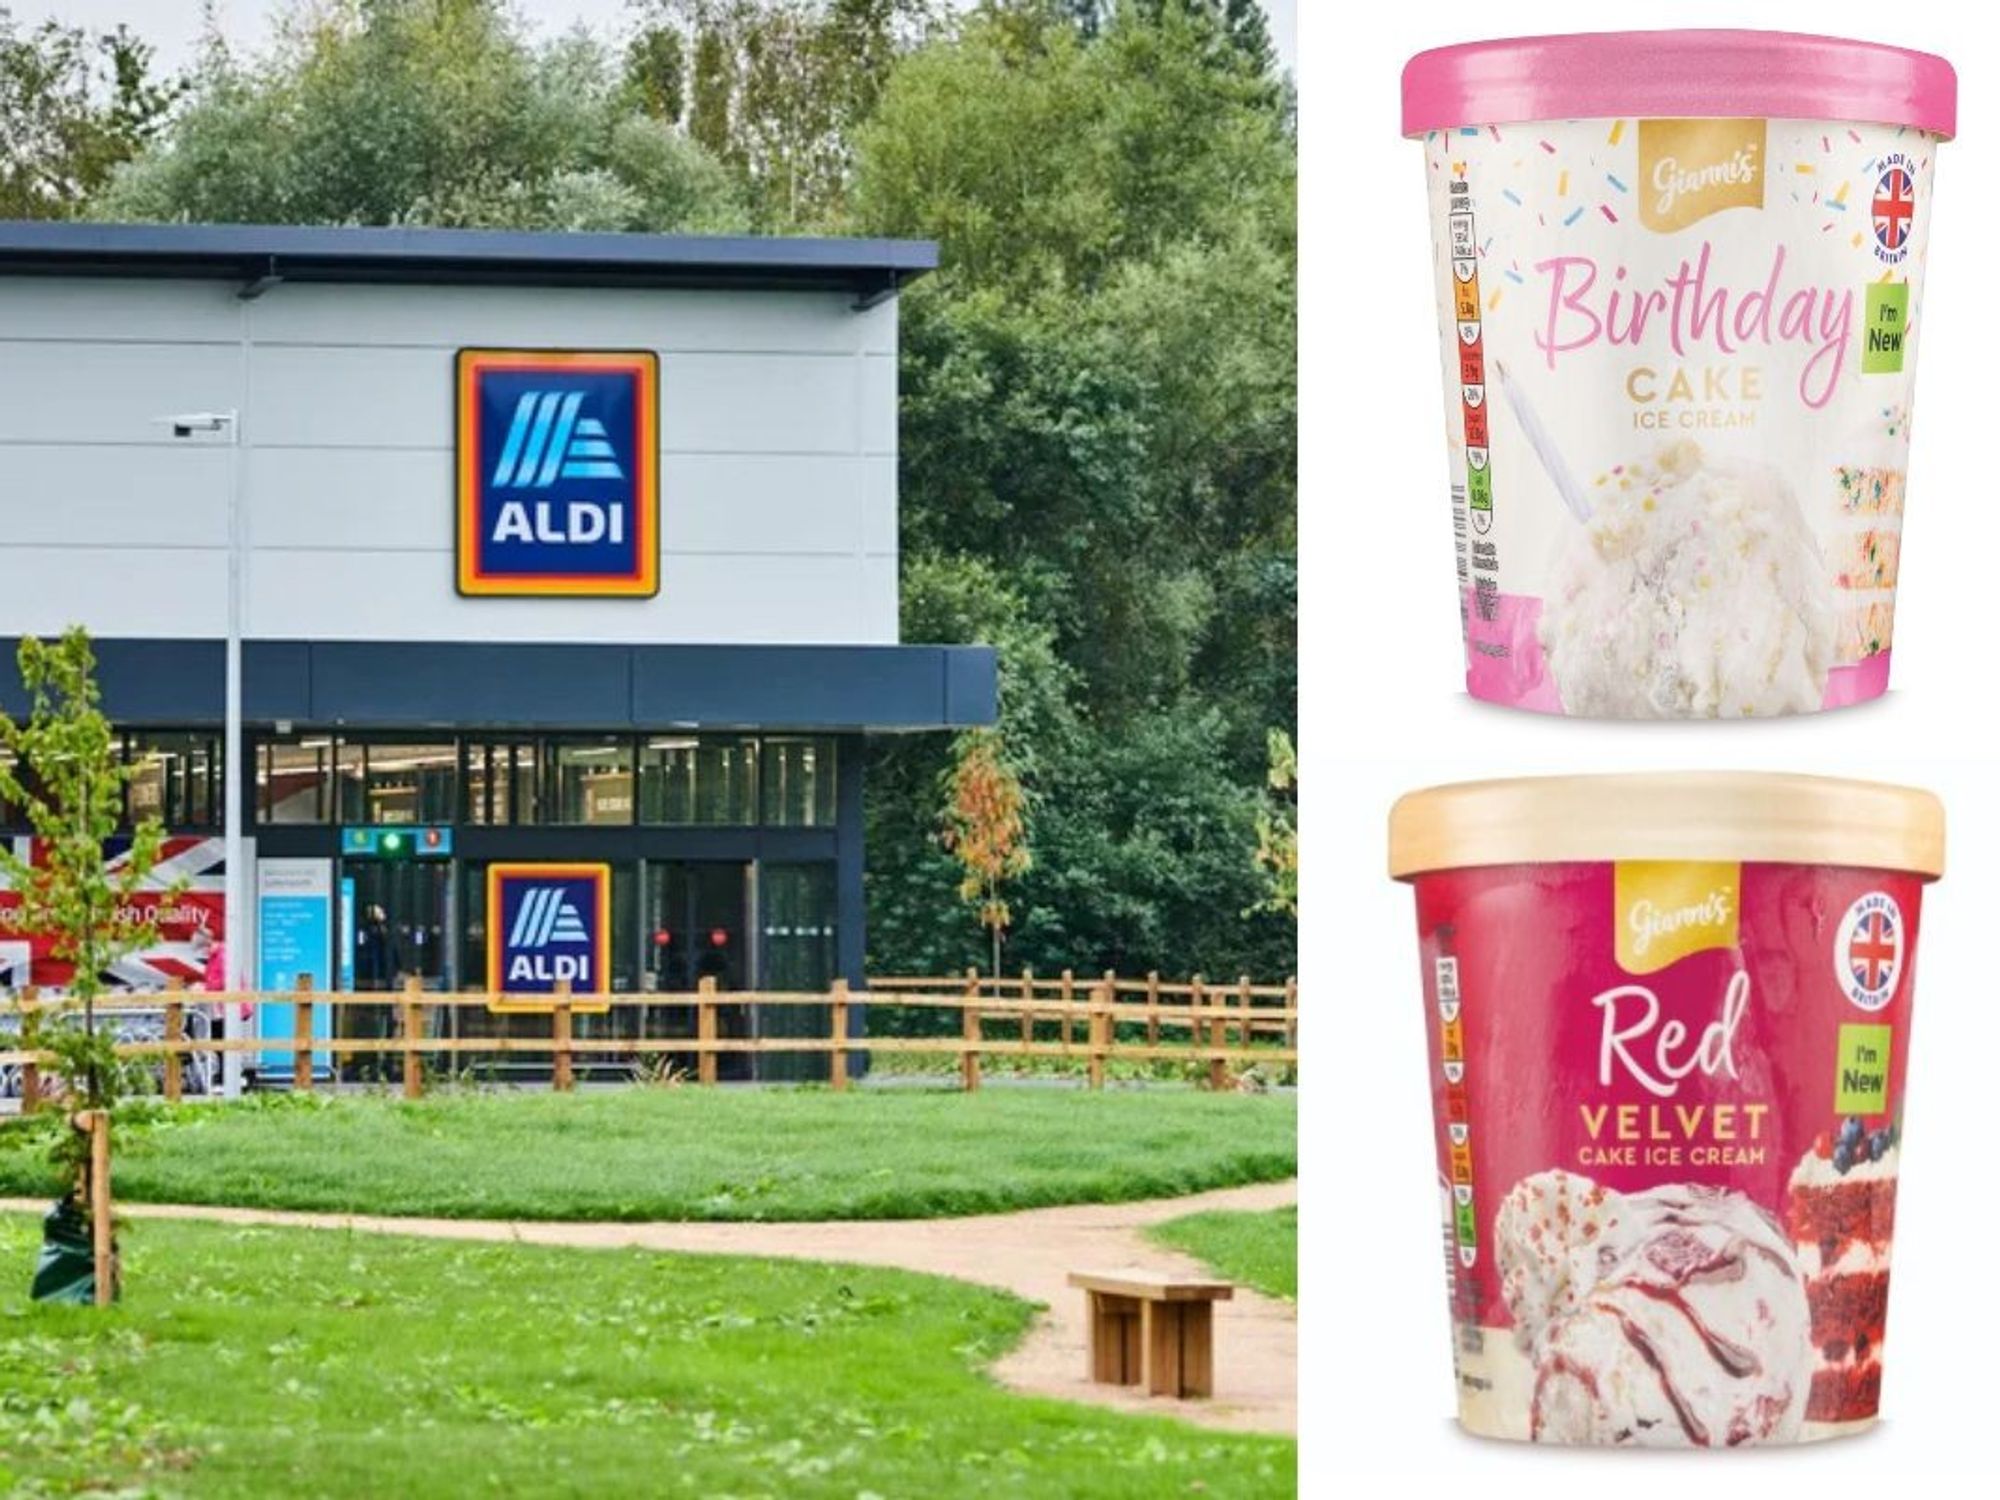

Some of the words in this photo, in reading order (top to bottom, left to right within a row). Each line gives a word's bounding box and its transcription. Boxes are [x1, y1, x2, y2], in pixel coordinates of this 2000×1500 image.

[1876, 152, 1905, 175] MADE
[1652, 149, 1757, 215] Gianni's
[1873, 243, 1909, 266] BRITAIN
[1534, 240, 1854, 410] Birthday
[1879, 303, 1898, 322] I'm
[1868, 327, 1903, 352] New
[1626, 366, 1763, 404] CAKE
[1633, 411, 1670, 430] ICE
[1678, 410, 1757, 430] CREAM
[491, 501, 624, 543] ALDI
[144, 904, 210, 929] Quality
[1855, 896, 1885, 917] MADE
[508, 954, 589, 982] ALDI
[1851, 985, 1889, 1006] BRITAIN
[1591, 969, 1750, 1098] Red
[1856, 1045, 1877, 1064] I'm
[1842, 1068, 1884, 1094] New
[1579, 1104, 1769, 1141] VELVET
[1578, 1146, 1637, 1167] CAKE
[1644, 1146, 1683, 1167] ICE
[1689, 1145, 1766, 1167] CREAM
